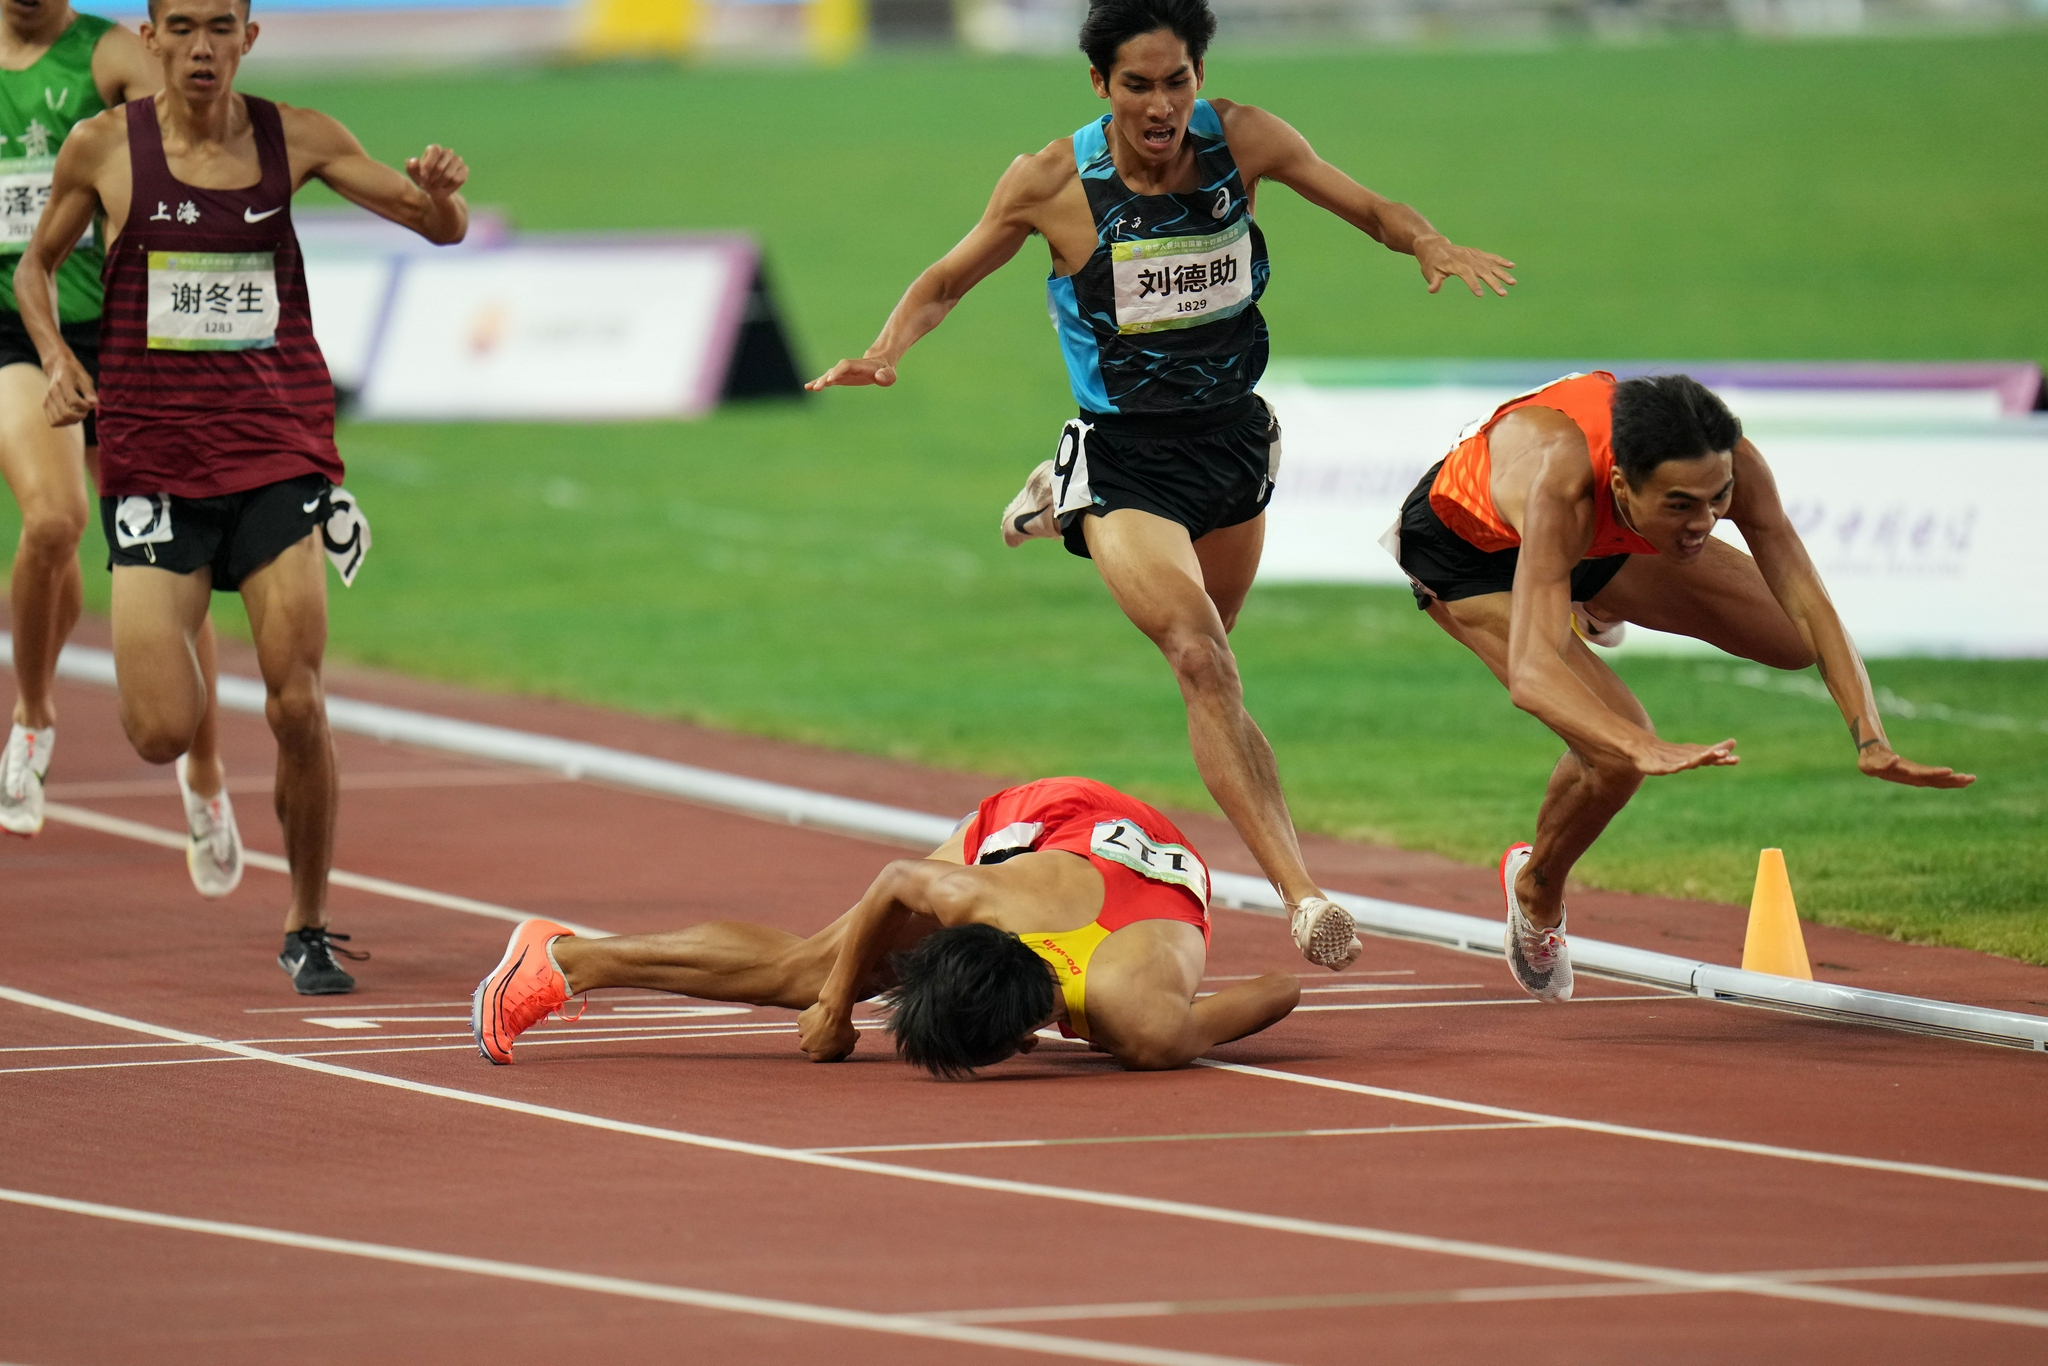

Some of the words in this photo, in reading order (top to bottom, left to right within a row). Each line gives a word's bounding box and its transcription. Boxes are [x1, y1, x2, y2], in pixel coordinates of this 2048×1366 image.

[149, 200, 201, 225] 上海
[1137, 254, 1237, 299] 刘德助
[171, 282, 263, 314] 谢冬生
[1176, 299, 1207, 313] 1829
[204, 322, 232, 334] 1283
[1054, 423, 1080, 509] 9
[1042, 939, 1082, 976] Do-win
